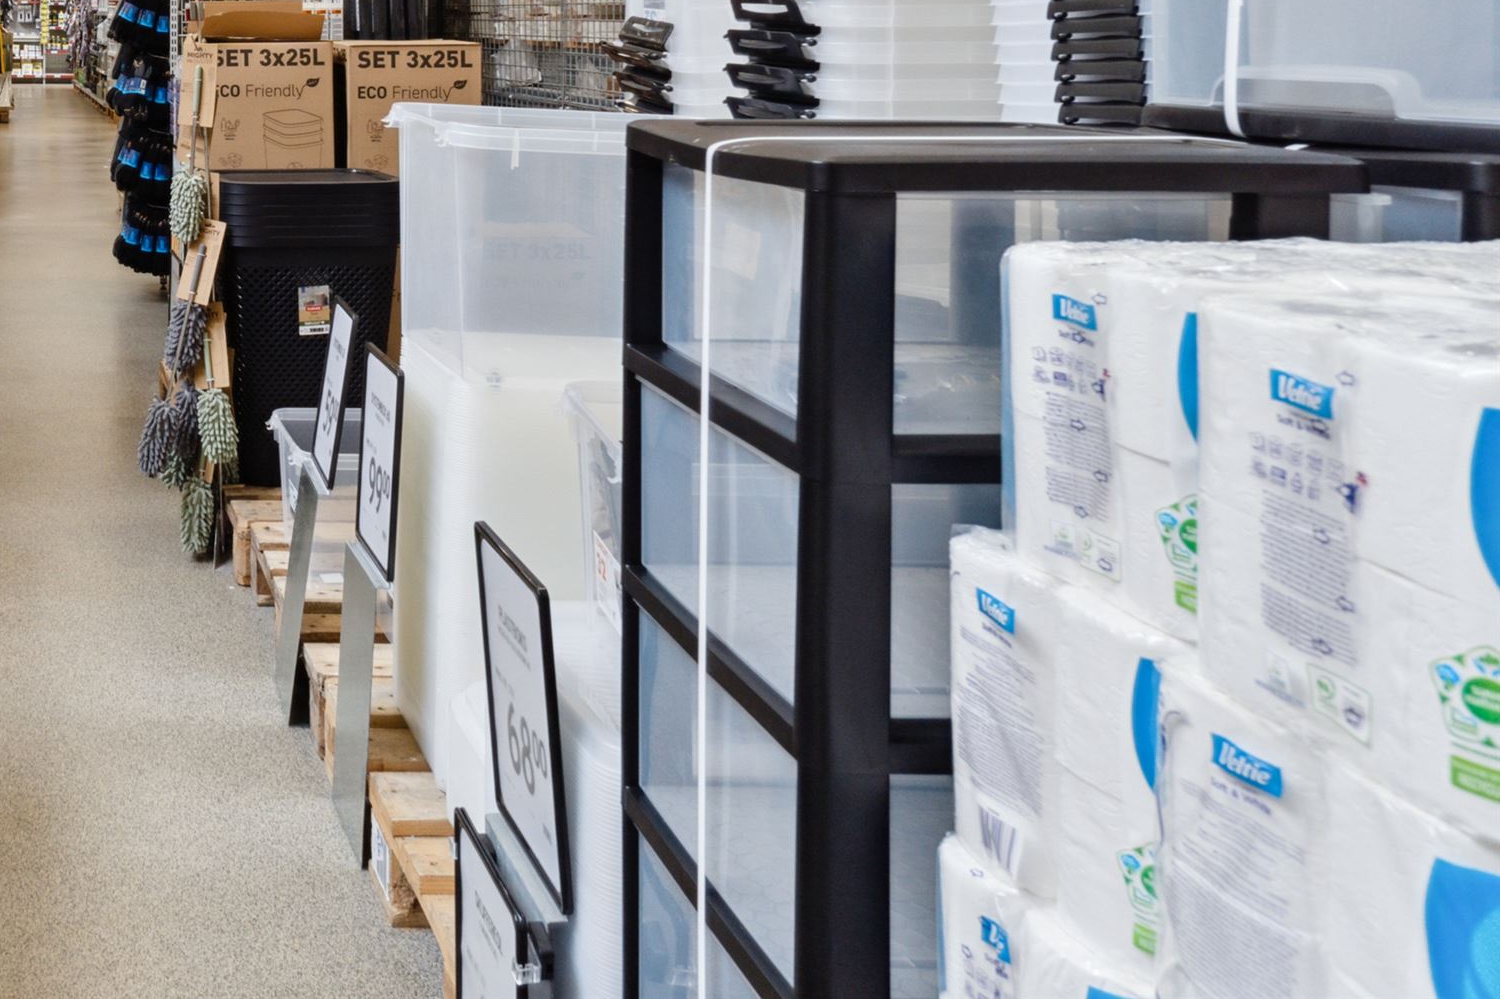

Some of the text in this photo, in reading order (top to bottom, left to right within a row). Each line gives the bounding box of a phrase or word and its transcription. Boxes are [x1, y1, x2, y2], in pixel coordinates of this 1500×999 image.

[260, 49, 325, 66] 3x25L
[358, 50, 473, 68] SET 3x25L
[216, 84, 303, 100] CO Friendly
[357, 86, 452, 101] ECO Friendly
[507, 702, 535, 796] 68
